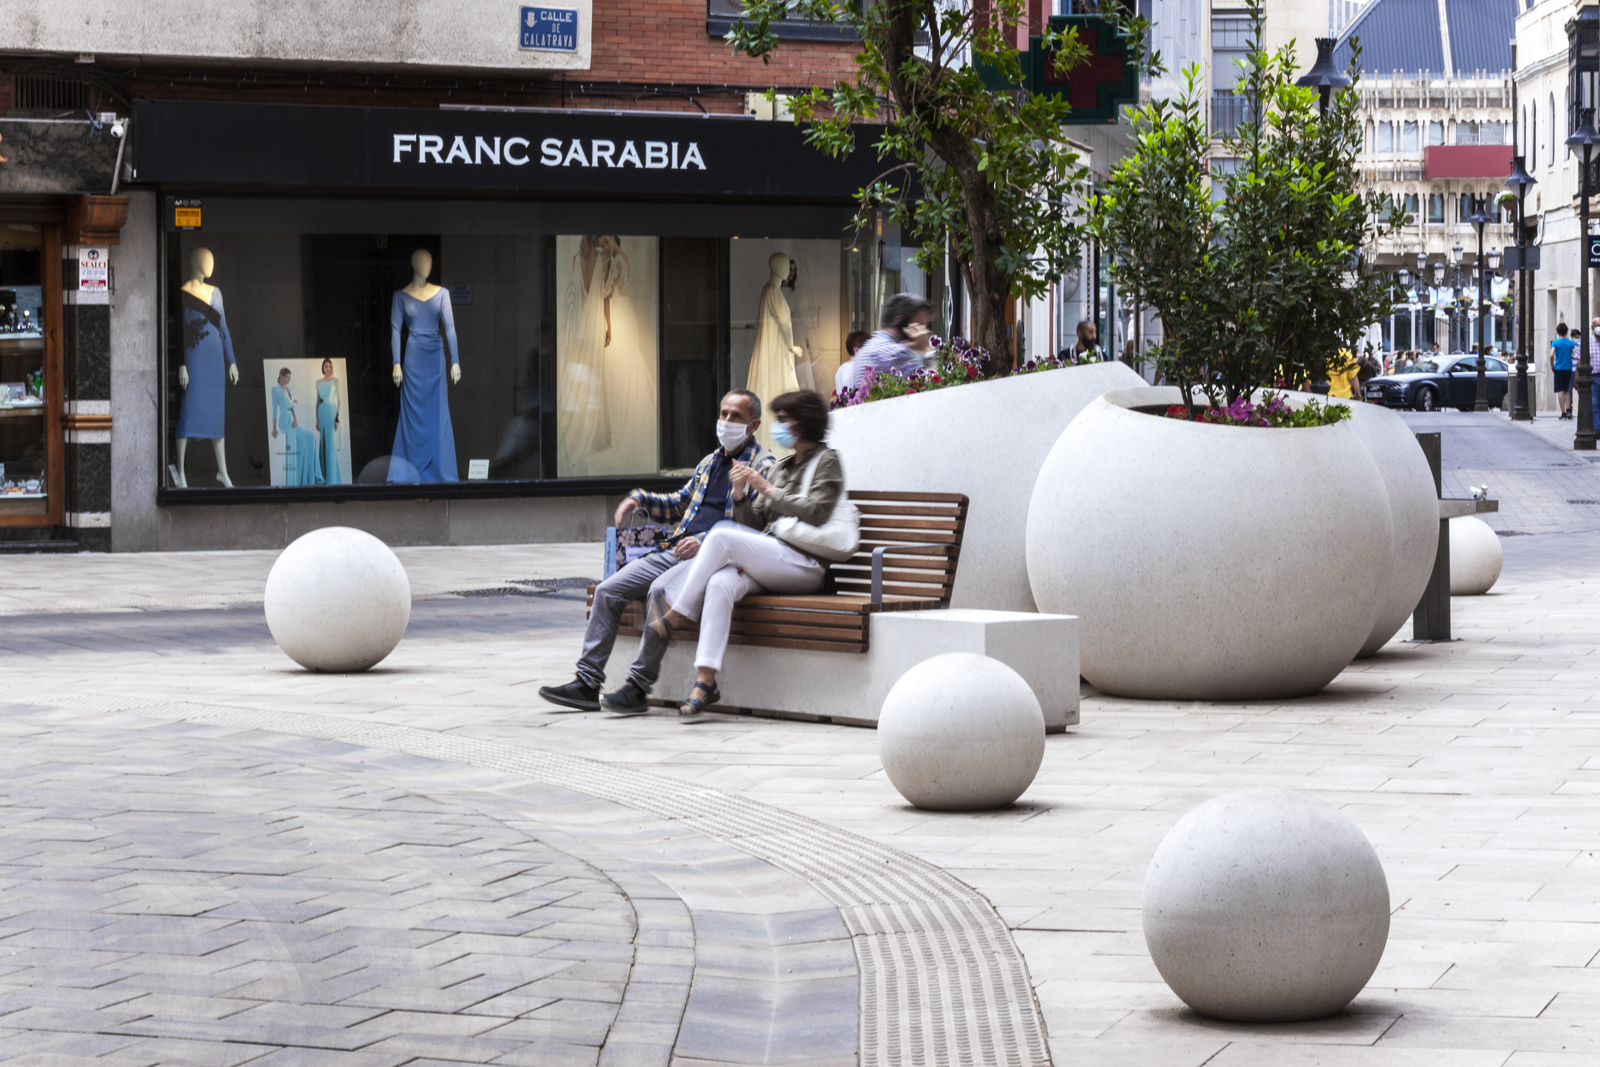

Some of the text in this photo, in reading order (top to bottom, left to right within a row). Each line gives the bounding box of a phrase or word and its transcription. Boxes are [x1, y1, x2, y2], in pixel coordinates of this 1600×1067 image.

[540, 10, 572, 23] CALLE
[551, 23, 561, 33] DE
[524, 32, 573, 48] CALATRAVA
[393, 133, 707, 170] FRANC SARABIA
